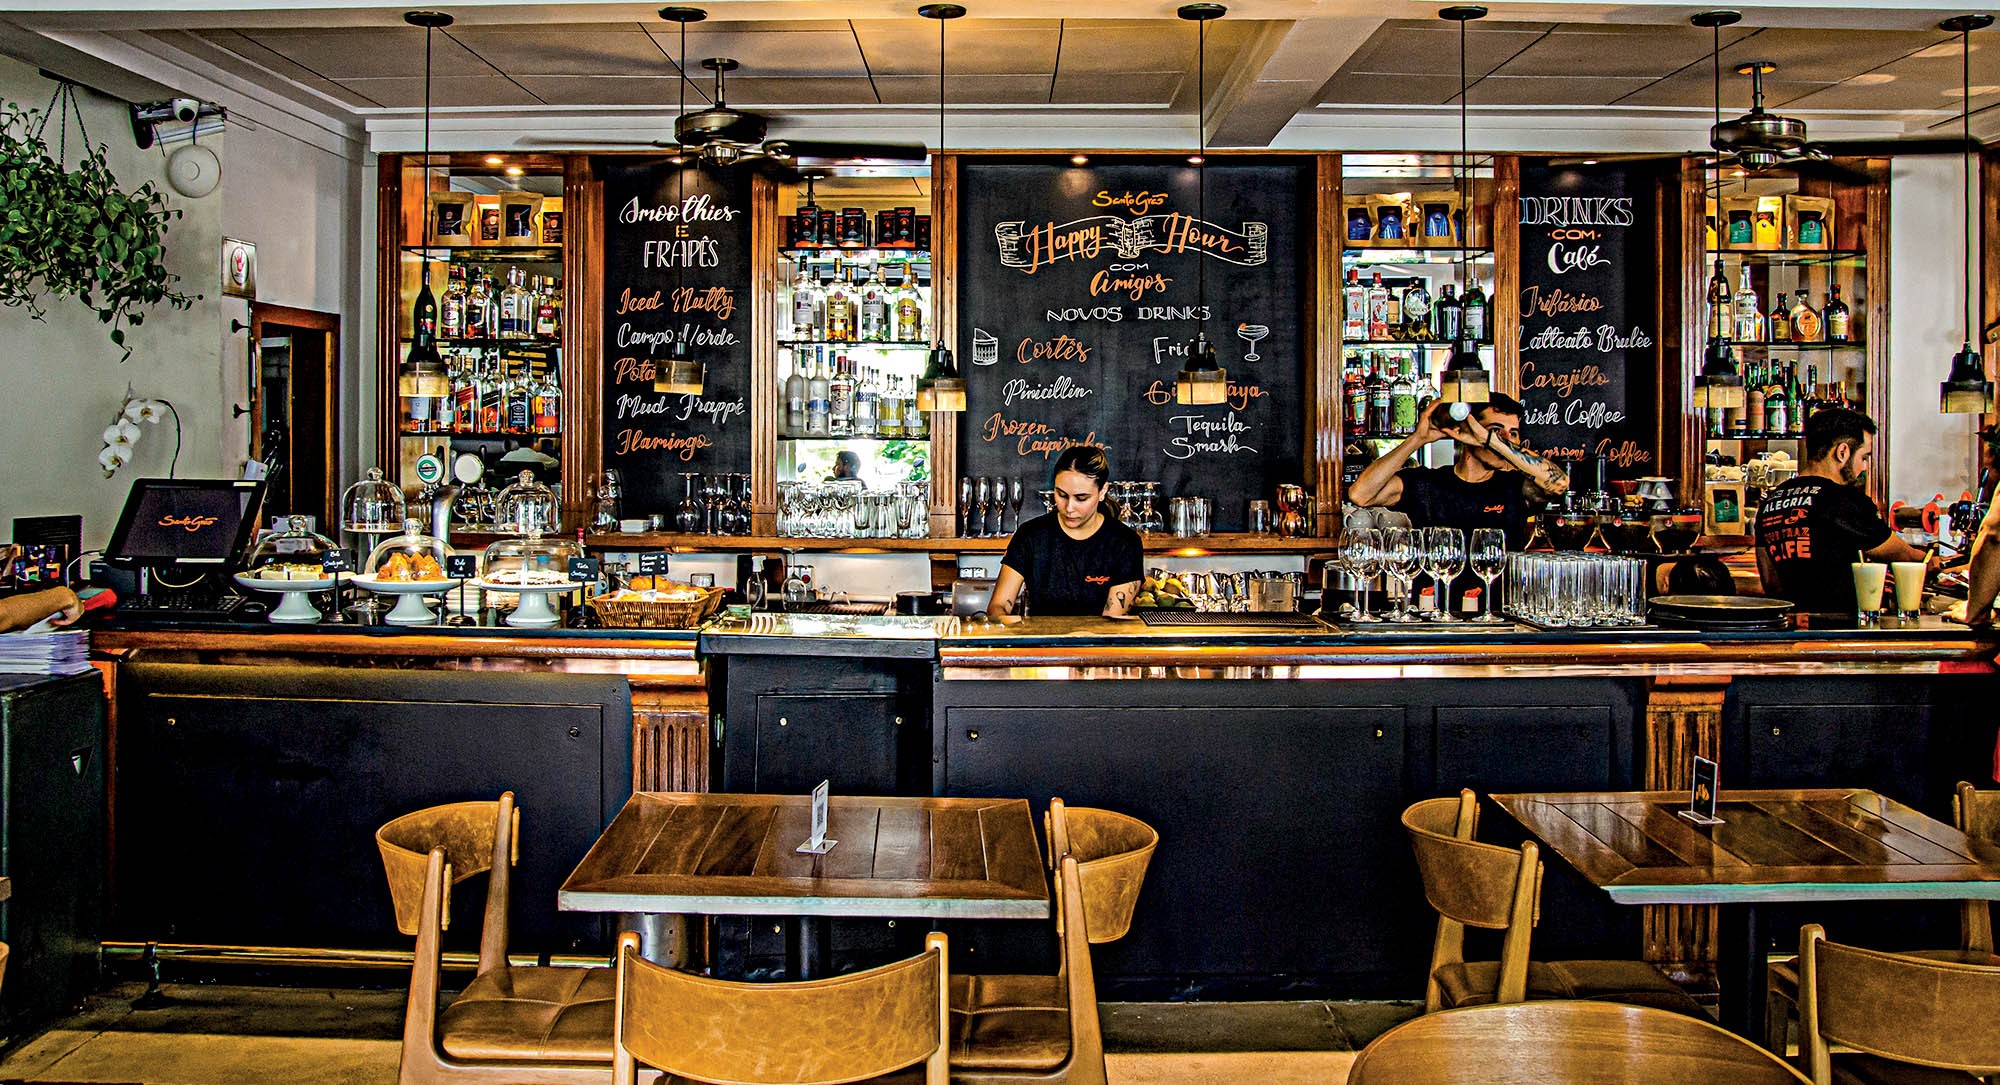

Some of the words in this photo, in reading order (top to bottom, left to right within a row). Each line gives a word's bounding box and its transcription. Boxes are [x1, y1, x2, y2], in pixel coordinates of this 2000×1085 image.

[619, 193, 741, 223] Smoothies
[1519, 196, 1634, 227] DRINKS
[676, 225, 689, 238] E
[1020, 221, 1107, 274] Happy
[1153, 212, 1245, 254] Hour
[1551, 229, 1596, 241] COM
[644, 235, 719, 268] FRAPÊS
[1109, 263, 1149, 271] COM
[1547, 242, 1611, 274] Café
[616, 287, 664, 315] Iced
[671, 287, 736, 320] Nutty
[1047, 306, 1123, 323] NOVOS
[1138, 306, 1211, 321] DRINKS
[1520, 286, 1604, 318] Trifásico
[617, 322, 674, 355] Campo
[1153, 336, 1195, 365] Fri
[1002, 375, 1093, 406] Pinicillin
[1519, 361, 1610, 398] Carajillo
[616, 393, 671, 419] Mud
[675, 393, 746, 424] Frappé
[1519, 399, 1560, 425] rish
[1564, 398, 1626, 429] Coffee
[982, 412, 1056, 442] Frozen
[1168, 411, 1252, 438] Tequila
[615, 428, 713, 461] Flamingo
[1162, 434, 1258, 460] Smash
[1594, 437, 1652, 468] Coffee
[1763, 496, 1812, 513] ALEGRIA
